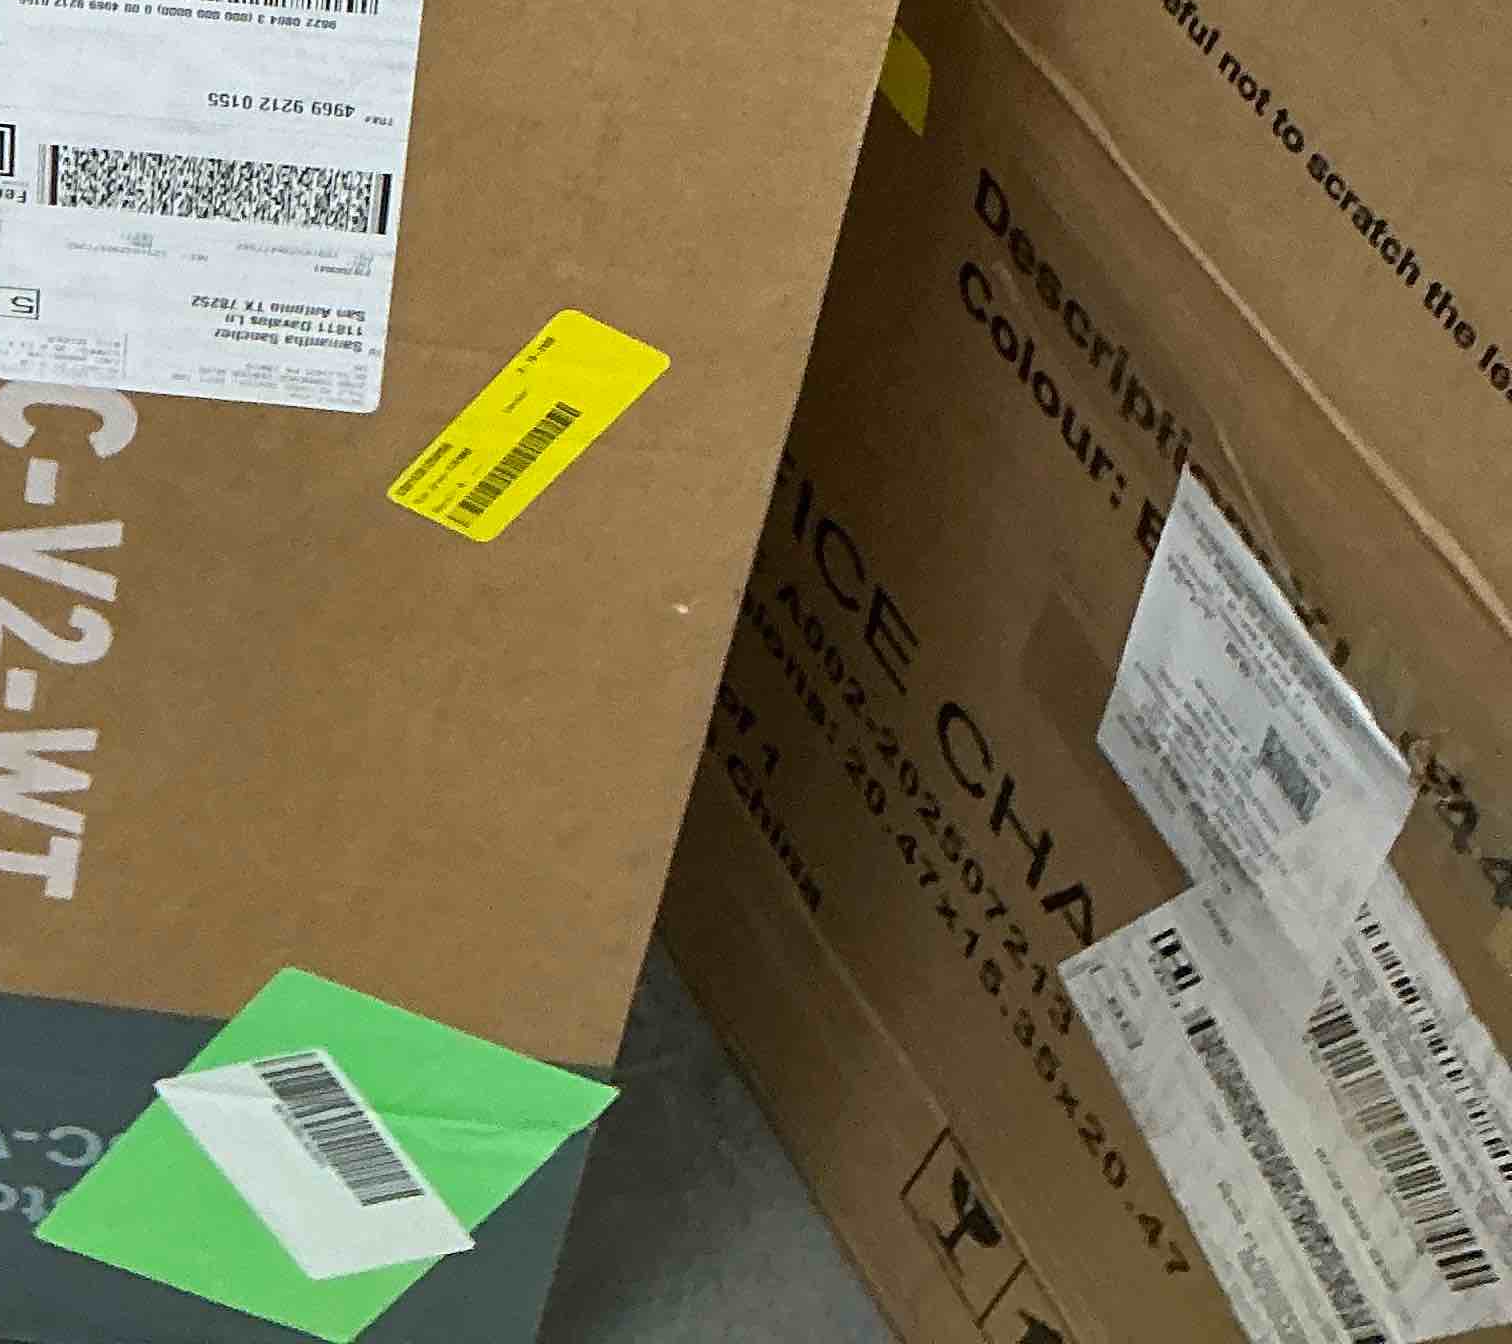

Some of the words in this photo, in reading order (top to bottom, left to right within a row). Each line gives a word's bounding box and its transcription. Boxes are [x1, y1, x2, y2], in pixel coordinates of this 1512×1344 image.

[205, 90, 253, 109] 0155
[257, 94, 303, 113] 9212
[309, 99, 355, 118] 4969
[1218, 52, 1271, 115] not
[1272, 108, 1304, 154] to
[1306, 153, 1420, 286] scratch
[1424, 282, 1476, 349] the
[8, 294, 34, 313] 5
[189, 292, 237, 311] 78252
[242, 297, 263, 313] TX
[267, 299, 331, 319] Antonio
[334, 304, 366, 321] San
[247, 312, 311, 333] Davalos
[212, 324, 279, 347] Sanchez
[281, 331, 363, 353] Samantha
[940, 253, 1126, 509] Colour:
[770, 447, 919, 696] ICE
[934, 701, 1093, 946] CHA
